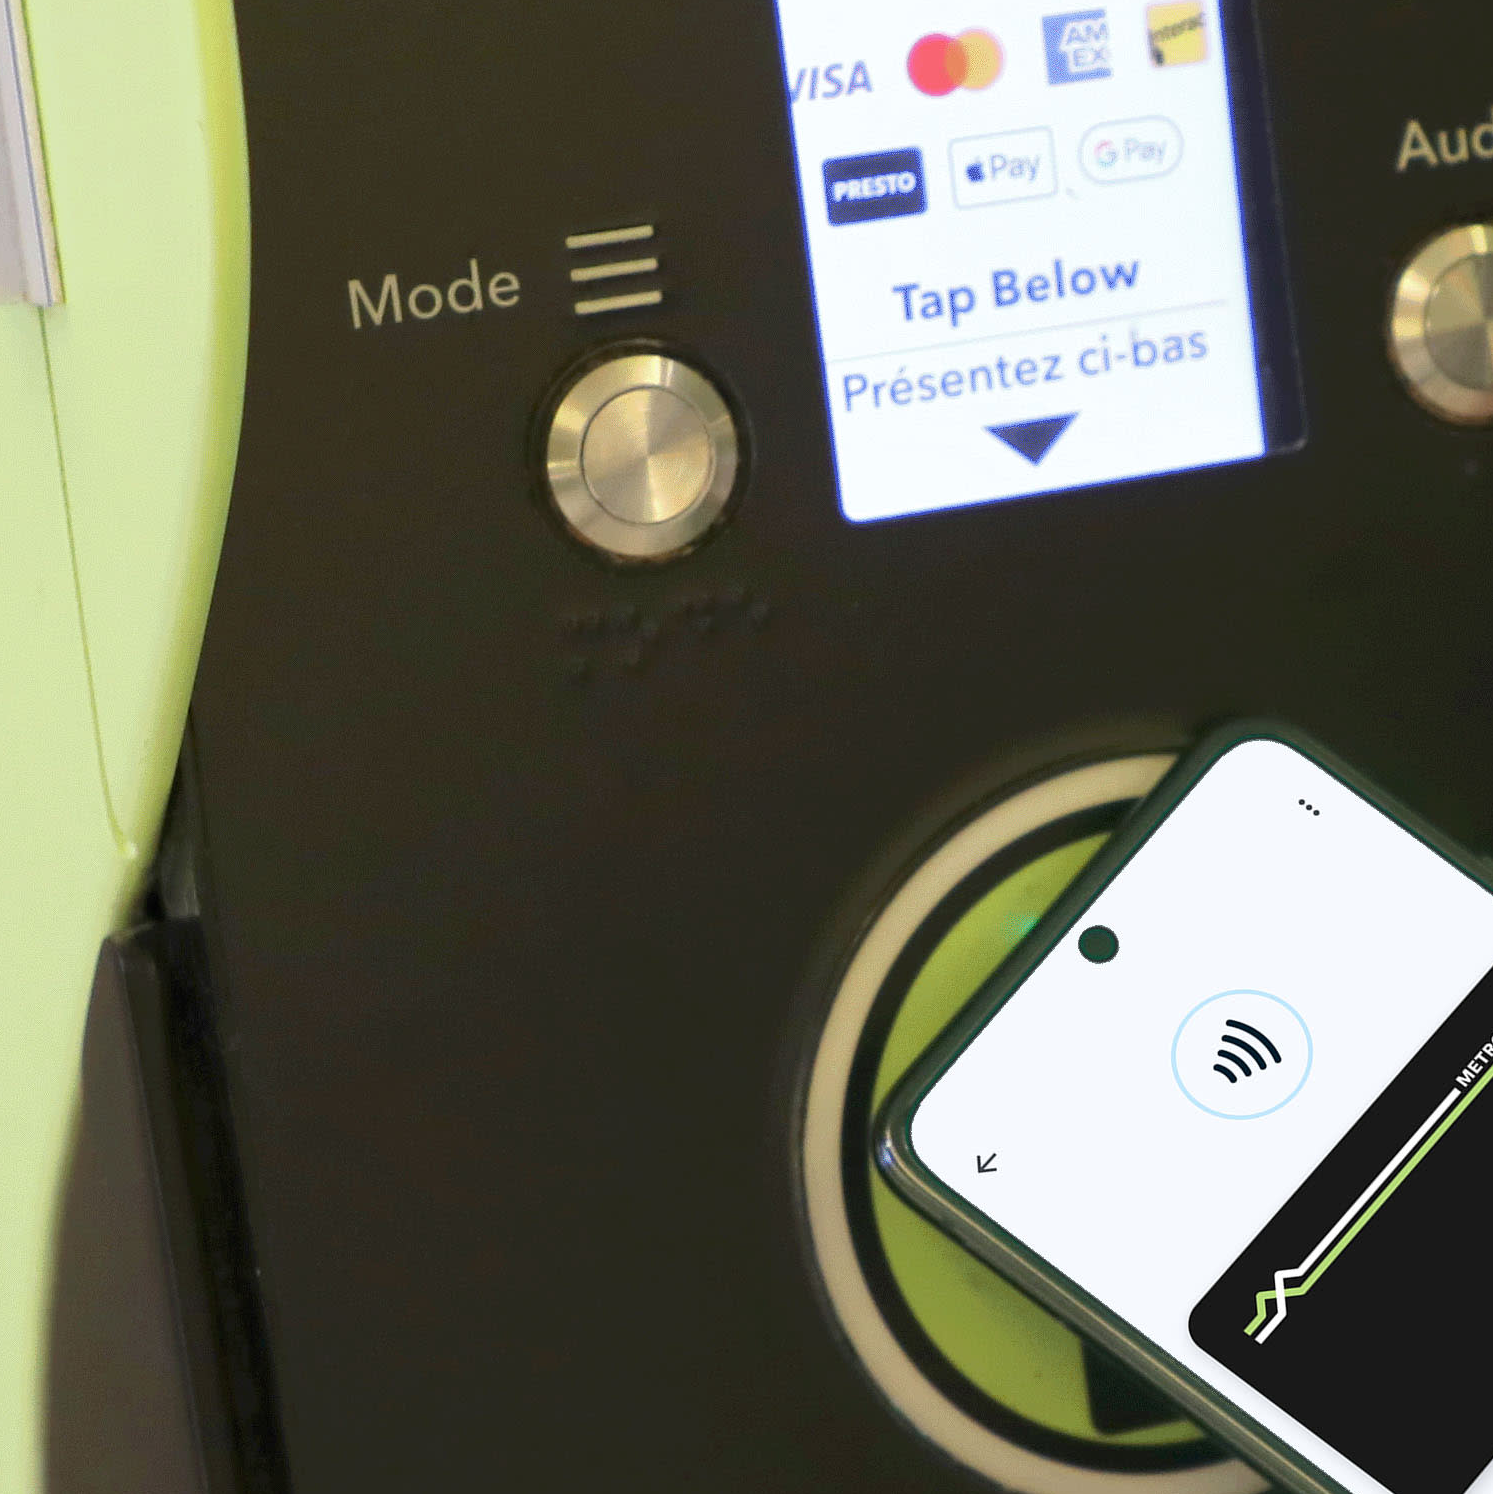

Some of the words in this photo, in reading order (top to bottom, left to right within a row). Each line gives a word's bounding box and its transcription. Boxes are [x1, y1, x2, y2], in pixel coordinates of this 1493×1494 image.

[990, 154, 1040, 182] Pay
[1124, 137, 1167, 165] Pay
[833, 170, 917, 203] PRESTO
[347, 258, 521, 329] Mode
[892, 282, 976, 328] Tap
[992, 258, 1140, 308] Below
[841, 353, 1063, 413] Présentez
[1077, 324, 1210, 377] ci-bas
